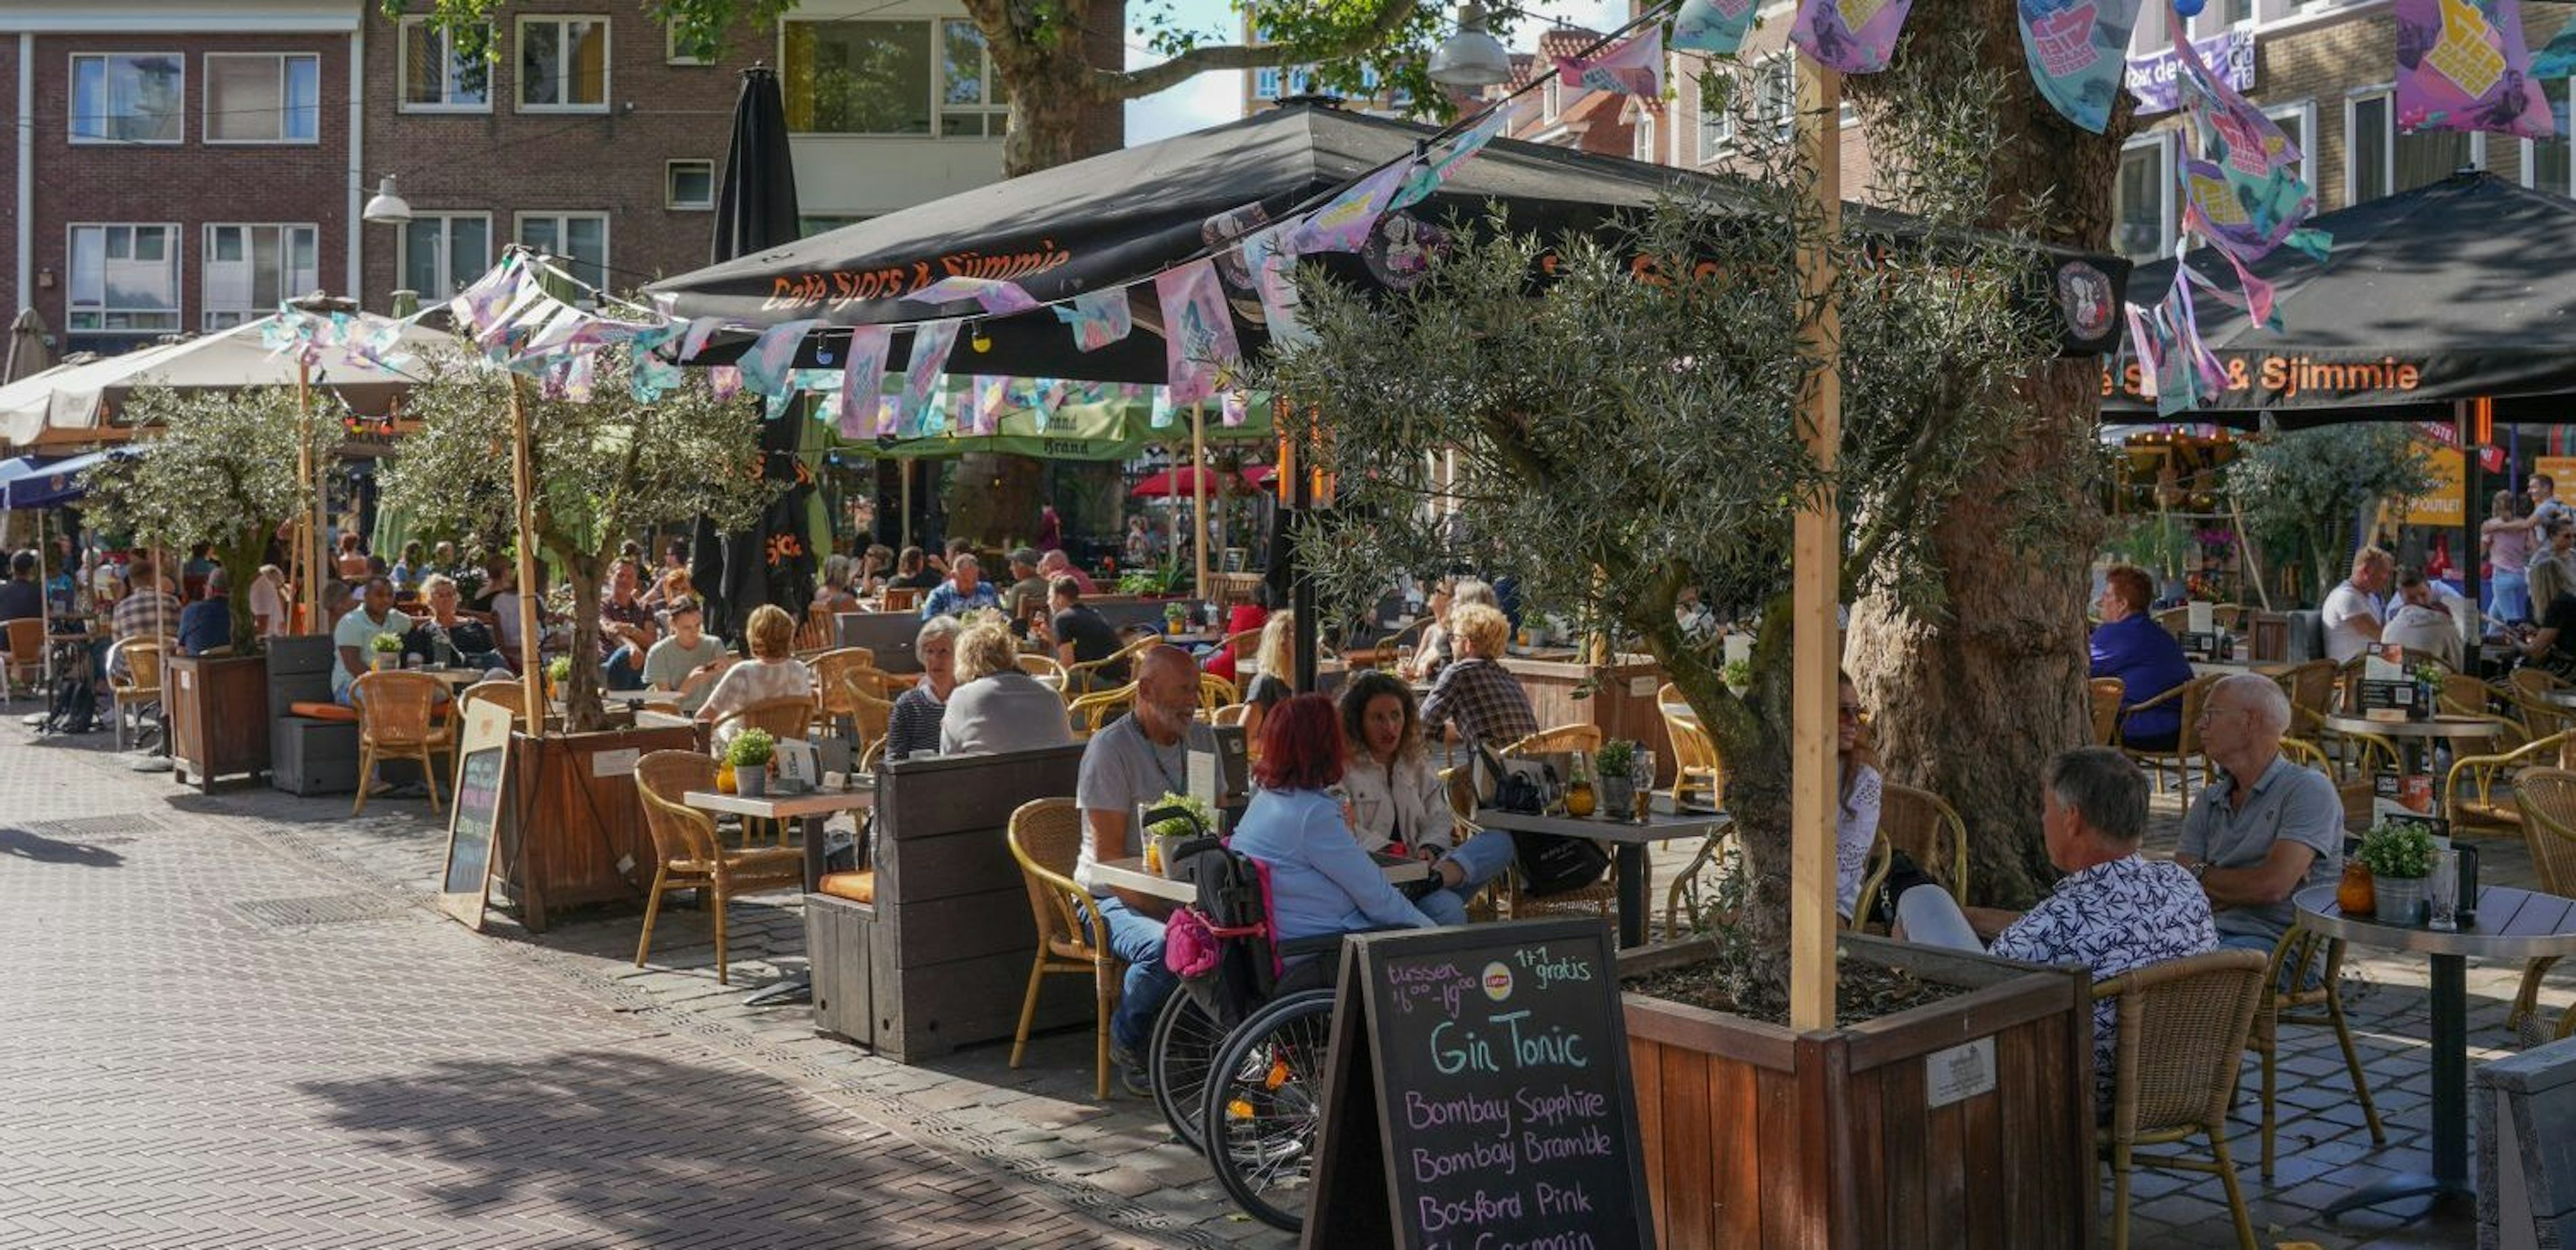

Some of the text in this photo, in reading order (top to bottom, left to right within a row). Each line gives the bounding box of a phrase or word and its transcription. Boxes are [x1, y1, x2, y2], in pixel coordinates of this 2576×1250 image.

[2228, 355, 2420, 397] & Sjimmie
[1388, 963, 1462, 984] tussen
[1514, 946, 1549, 967] 1+1
[1535, 955, 1592, 990] gratis
[1430, 1009, 1588, 1076] Gin Tonic
[1405, 1084, 1607, 1138] Bombay Sapphire
[1412, 1124, 1612, 1182] Bombay Bramble
[1536, 1180, 1593, 1216] Pink
